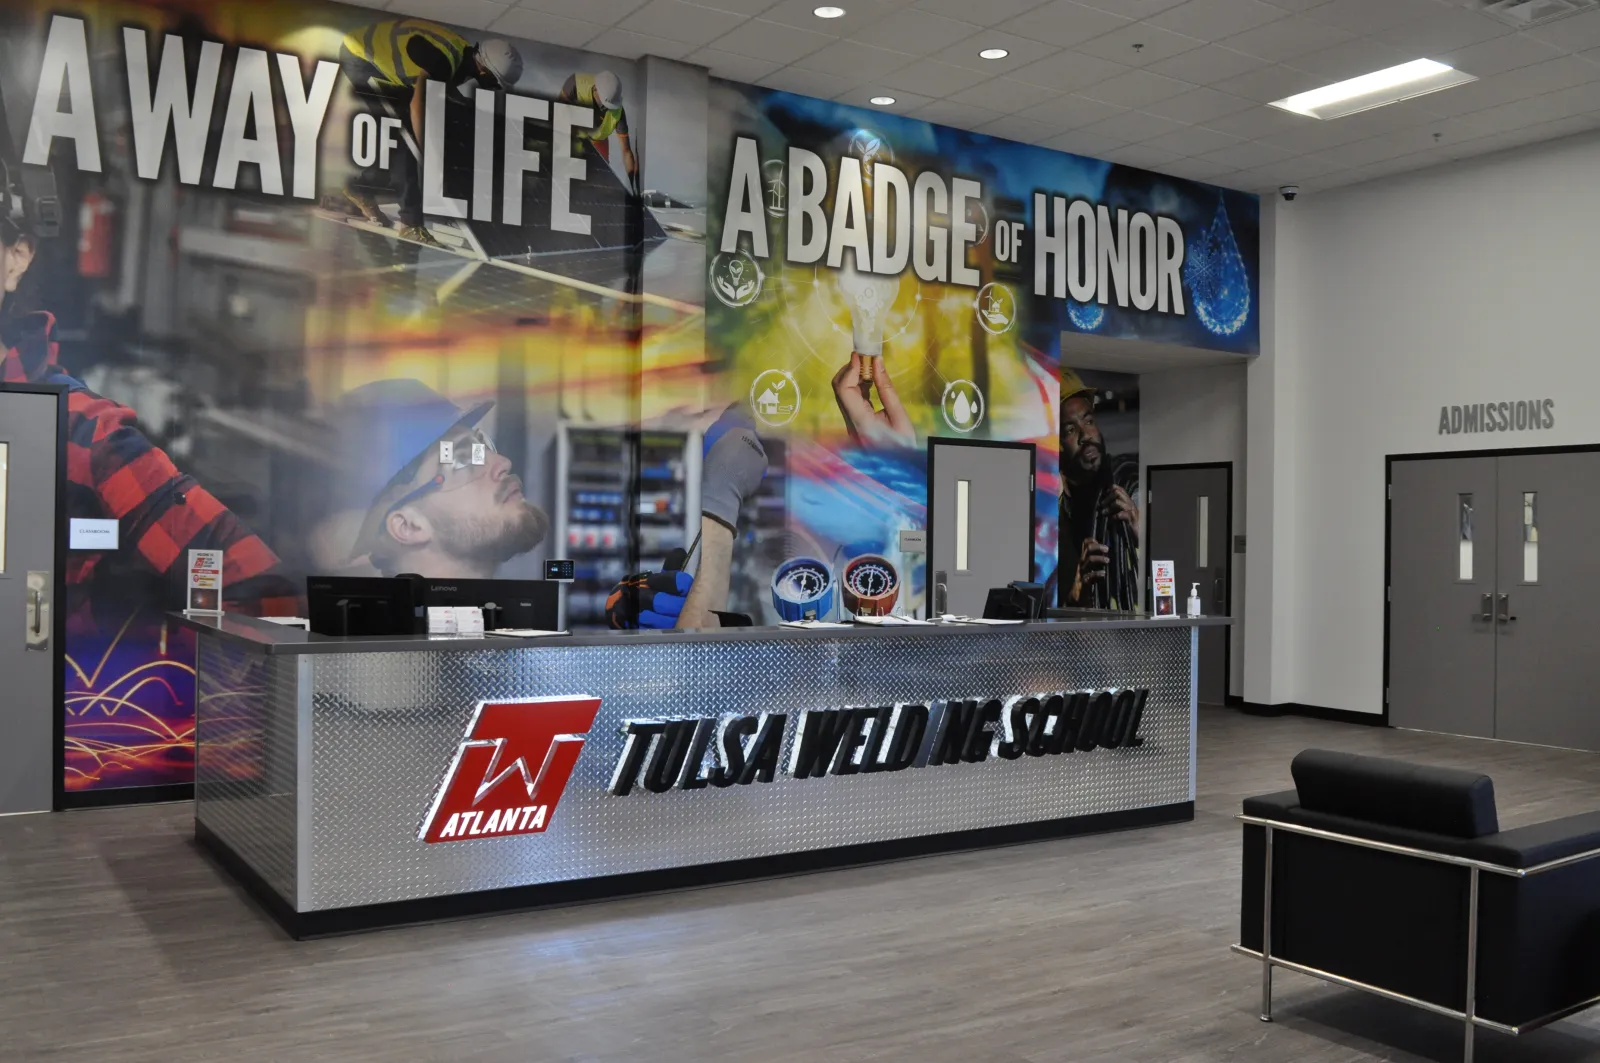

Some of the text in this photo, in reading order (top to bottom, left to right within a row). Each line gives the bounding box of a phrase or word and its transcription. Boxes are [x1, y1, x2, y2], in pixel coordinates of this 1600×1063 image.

[23, 14, 594, 236] A WAY OF LIFE
[720, 137, 1186, 316] A BADGE OF HONOR
[1438, 398, 1555, 435] ADMISSIONS
[430, 584, 457, 592] Lenovo
[610, 688, 1148, 796] TULSA WELDING SCHOOL
[439, 804, 548, 838] ATLANTA
